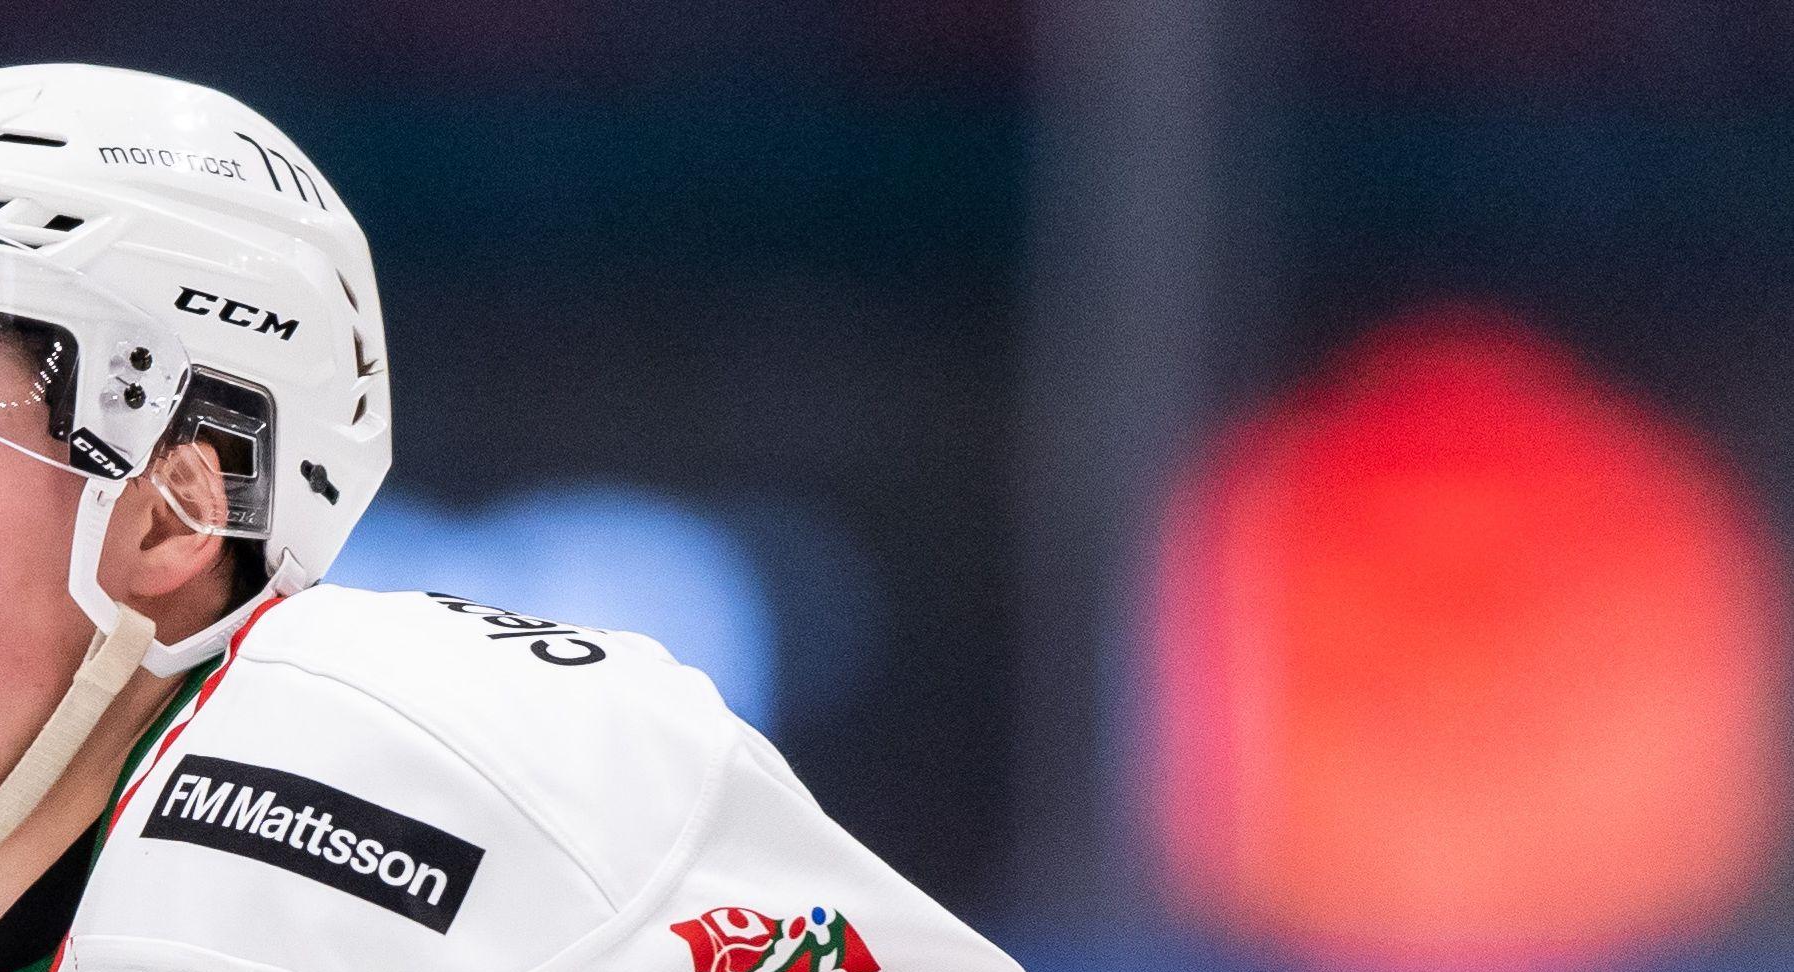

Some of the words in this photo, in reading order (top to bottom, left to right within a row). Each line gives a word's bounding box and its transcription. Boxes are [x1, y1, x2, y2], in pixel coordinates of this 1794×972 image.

[174, 285, 300, 342] CCM
[72, 436, 125, 478] CCM
[161, 773, 235, 825] FM
[221, 786, 449, 907] Mattsson
